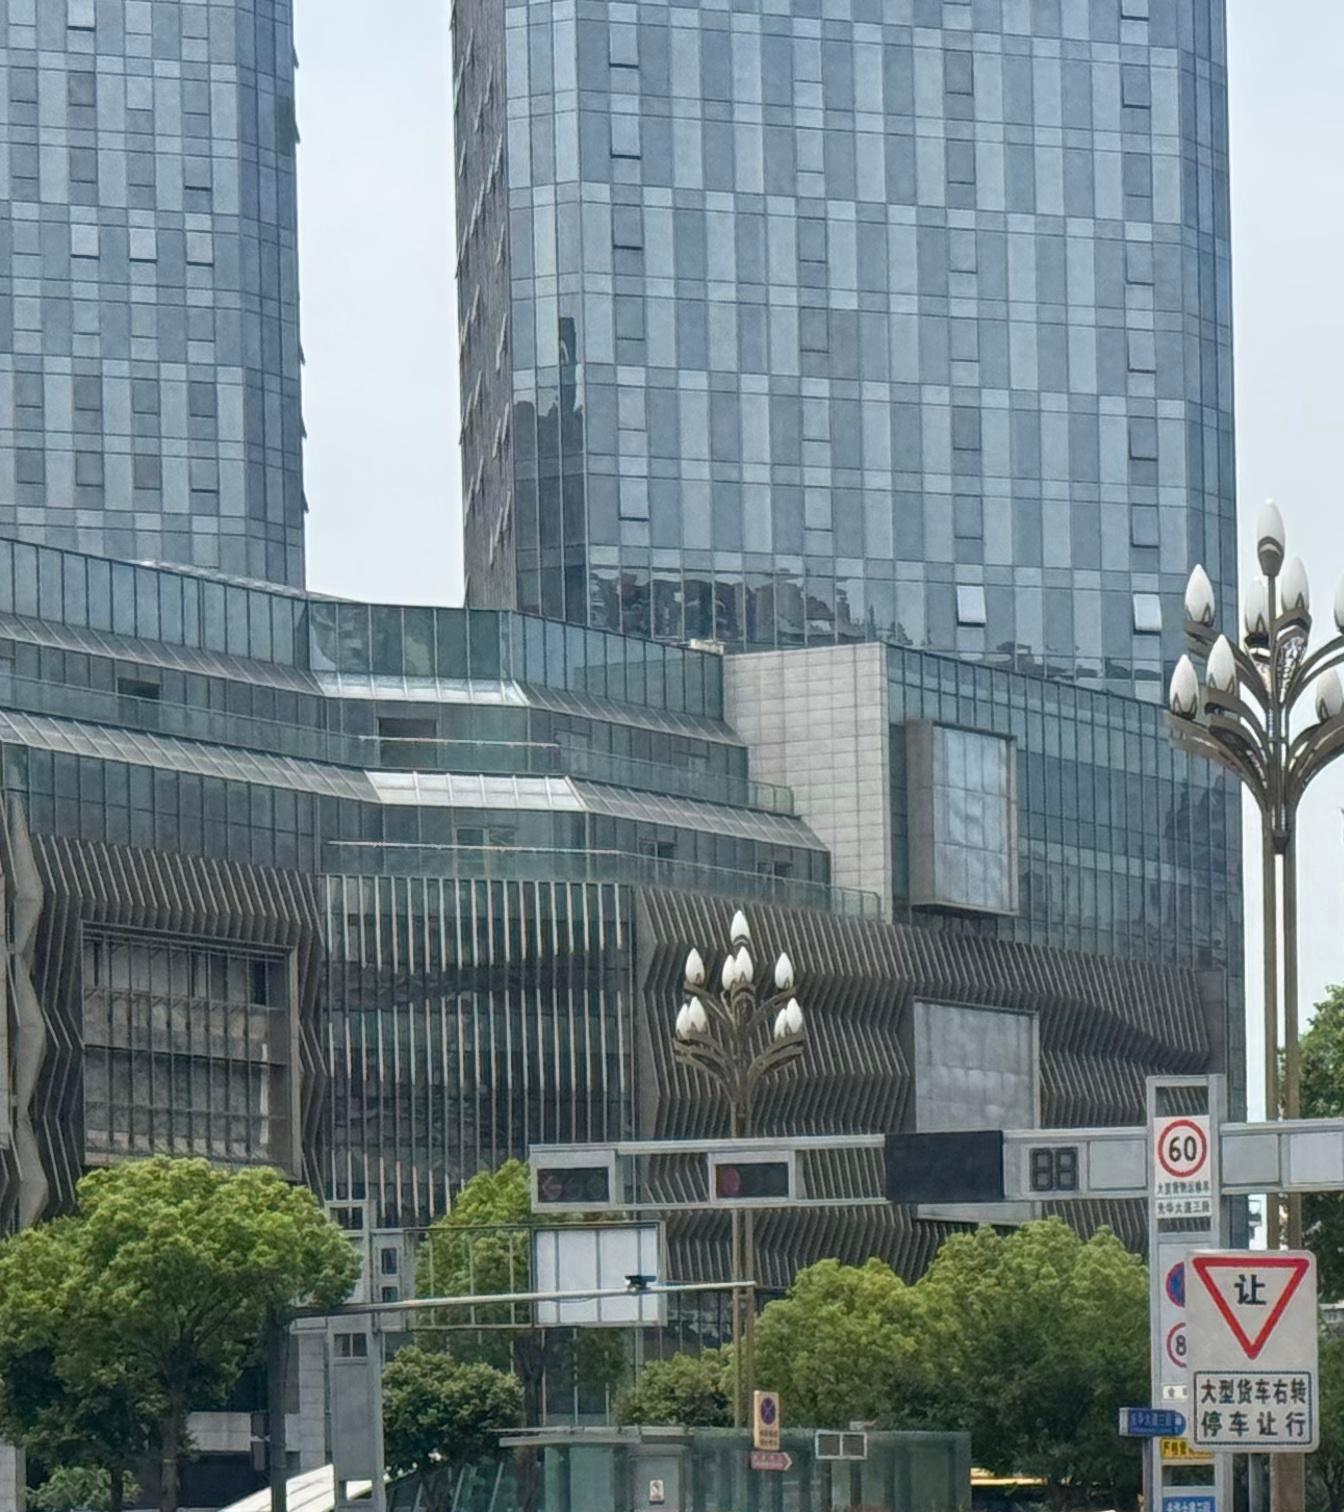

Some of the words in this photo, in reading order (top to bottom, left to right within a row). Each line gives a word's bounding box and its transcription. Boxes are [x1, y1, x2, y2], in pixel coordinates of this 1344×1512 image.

[1168, 1135, 1197, 1163] 60
[1234, 1274, 1267, 1306] 让
[1200, 1379, 1307, 1405] 大型货车右转
[1200, 1410, 1307, 1438] 停车让行
